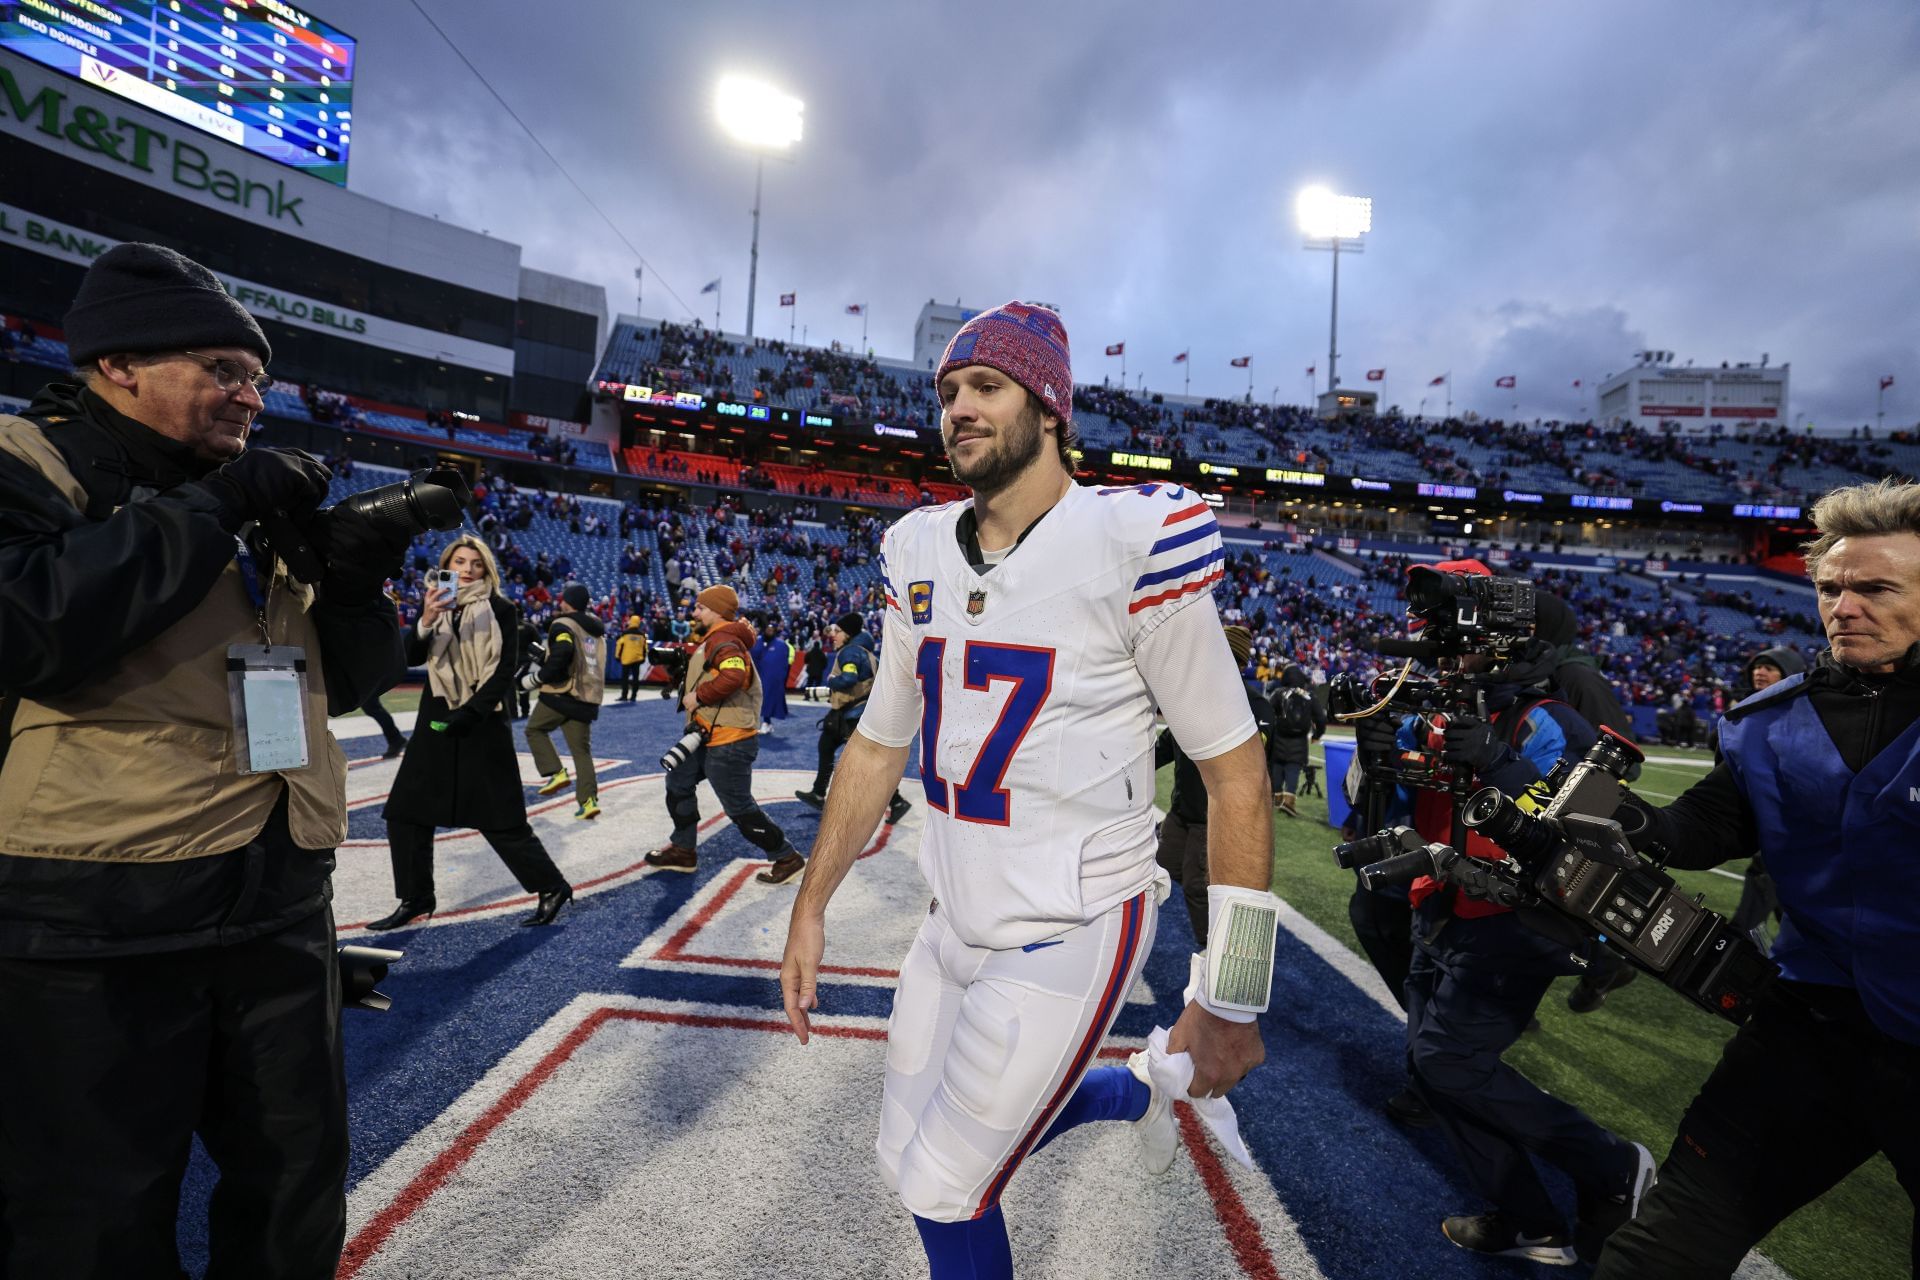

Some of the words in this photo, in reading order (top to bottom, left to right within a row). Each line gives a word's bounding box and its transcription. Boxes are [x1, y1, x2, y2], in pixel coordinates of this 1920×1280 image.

[18, 14, 47, 34] RICO
[48, 26, 98, 57] DOWDLE
[60, 10, 112, 41] HODGINS
[0, 64, 168, 174] M&T
[172, 140, 305, 226] Bank
[26, 219, 107, 258] BANK
[312, 304, 366, 334] BILLS
[629, 388, 646, 398] 32
[680, 396, 696, 406] 44
[716, 402, 746, 416] 0:00
[1112, 452, 1129, 466] BET
[1130, 454, 1148, 469] LIVE
[910, 584, 930, 612] C
[916, 636, 1056, 828] 17
[1650, 914, 1676, 947] ARRI
[1715, 939, 1727, 950] 3
